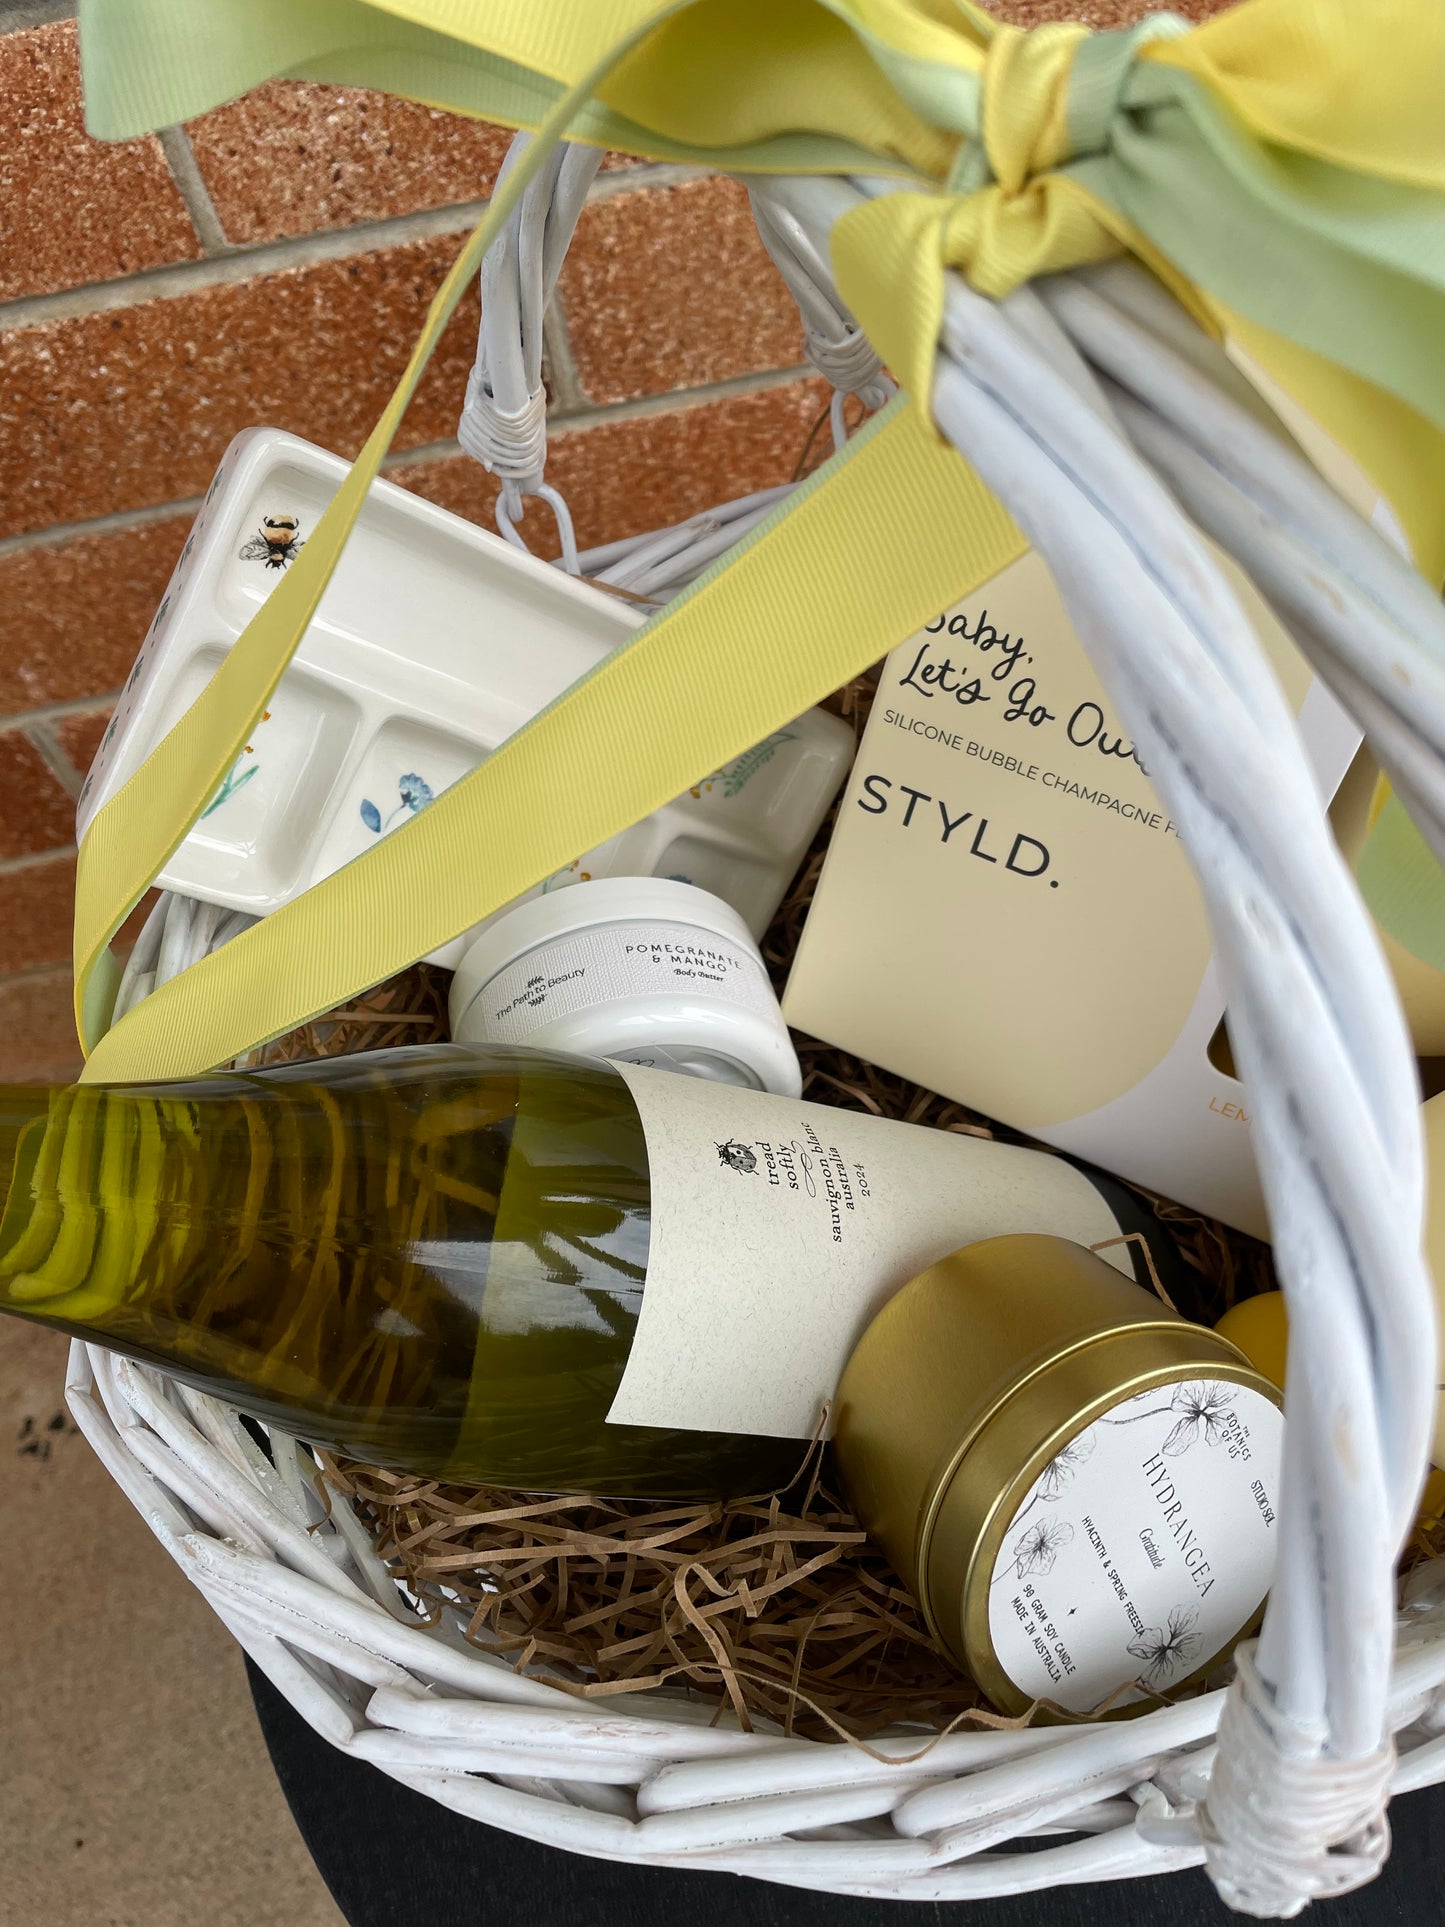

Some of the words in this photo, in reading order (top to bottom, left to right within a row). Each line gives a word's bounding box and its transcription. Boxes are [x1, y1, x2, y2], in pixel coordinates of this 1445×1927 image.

[900, 644, 990, 705] Let's
[883, 709, 963, 750] SILICONE
[965, 740, 1039, 780] BUBBLE
[1041, 771, 1163, 829] CHAMPAGNE
[858, 774, 1059, 889] STYLD.
[625, 944, 742, 970] POMEGRANATE
[652, 955, 660, 963] &
[671, 955, 727, 972] MANGO
[674, 968, 696, 978] Body
[698, 971, 724, 982] Butter
[496, 1005, 512, 1020] The
[513, 991, 534, 1008] Path
[535, 985, 546, 993] to
[548, 968, 585, 988] Beauty
[801, 1122, 823, 1154] blanc
[755, 1141, 780, 1186] tread
[777, 1144, 799, 1190] softly
[829, 1147, 855, 1210] australia
[853, 1164, 871, 1197] 2024
[819, 1158, 842, 1243] sauvignon
[1221, 1429, 1232, 1442] OF
[1228, 1445, 1240, 1459] US
[1226, 1412, 1251, 1461] BOTANICS
[1242, 1426, 1250, 1438] THE
[1139, 1528, 1165, 1569] Gratitude
[1142, 1452, 1215, 1597] HYDRANGEA
[1082, 1515, 1107, 1559] HYACINTH
[1102, 1559, 1111, 1569] &
[1107, 1568, 1128, 1601] SPRING
[1123, 1601, 1146, 1638] FREESIA
[1011, 1596, 1029, 1621] MADE
[1024, 1621, 1037, 1636] IN
[1032, 1636, 1062, 1684] AUSTRALIA
[1023, 1583, 1035, 1598] 90
[1031, 1598, 1048, 1623] GRAM
[1044, 1623, 1059, 1641] SOY
[1054, 1642, 1076, 1675] CANDLE
